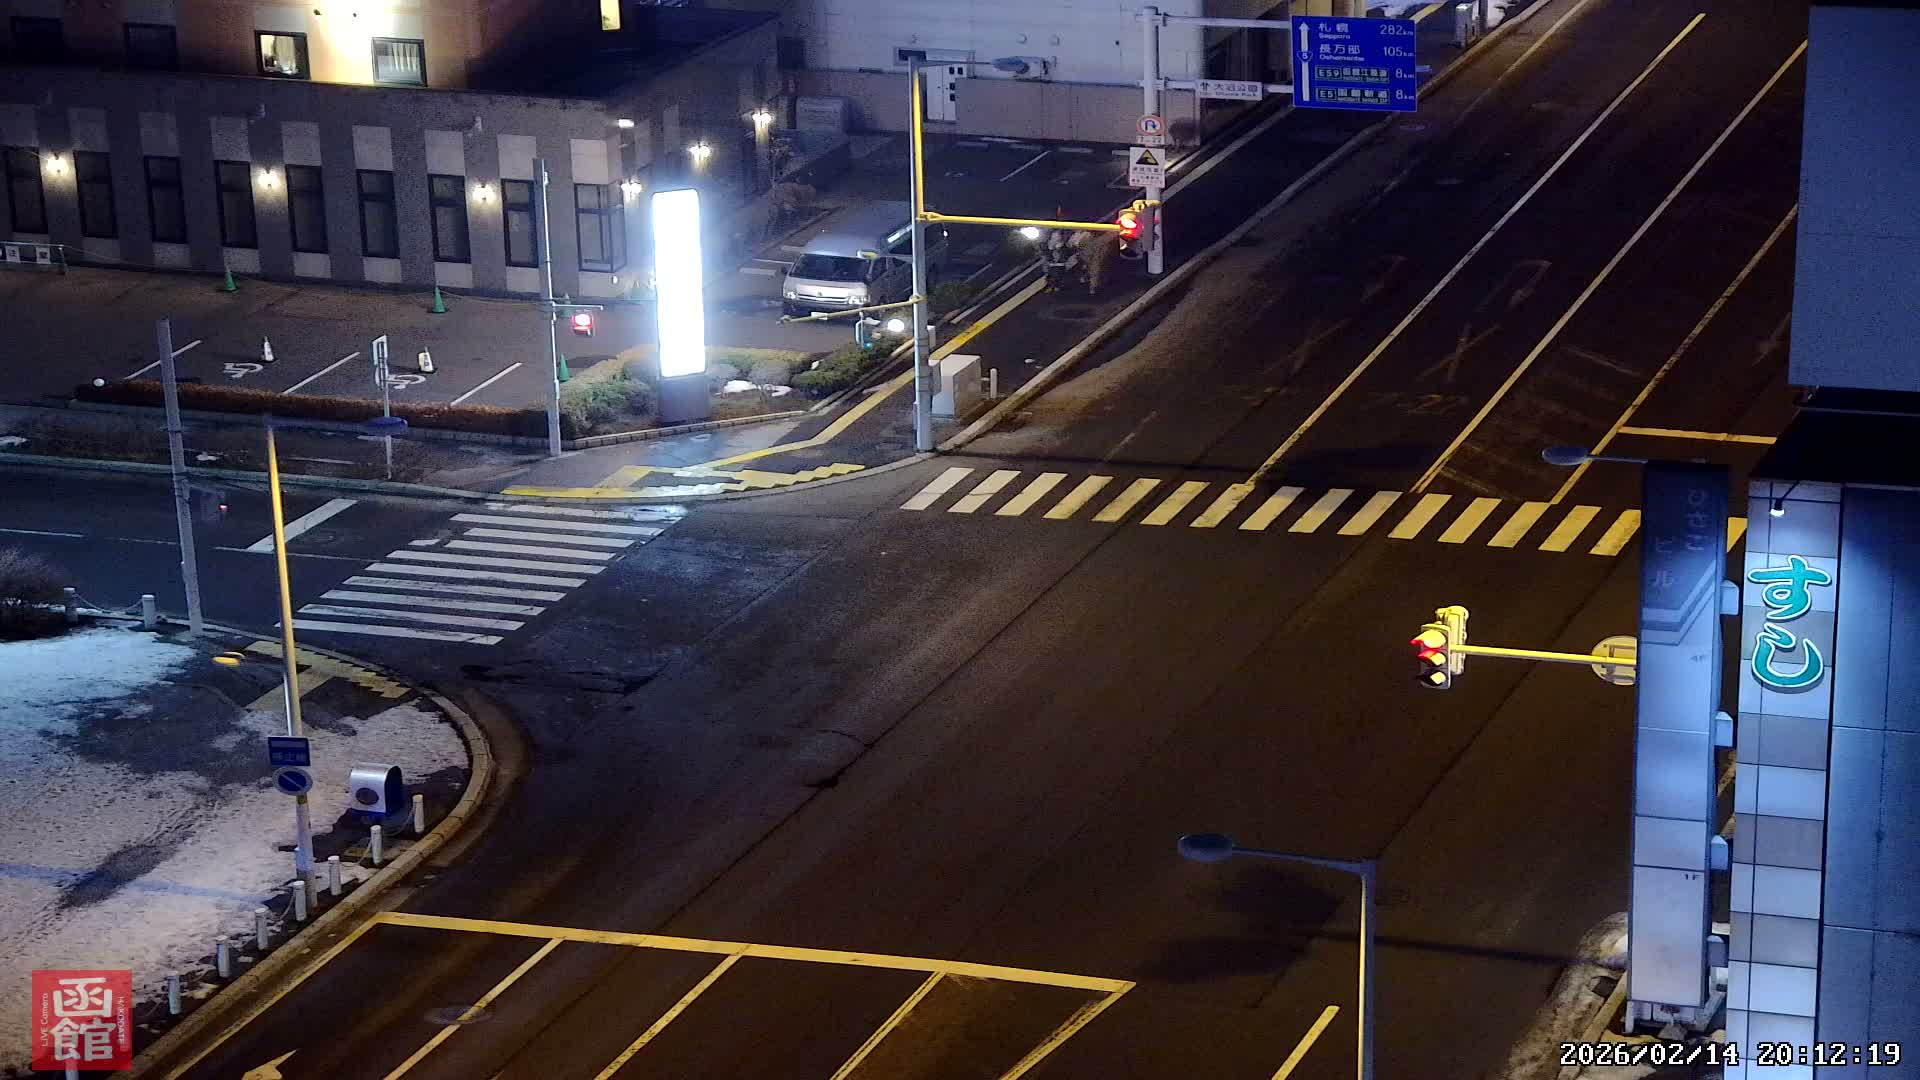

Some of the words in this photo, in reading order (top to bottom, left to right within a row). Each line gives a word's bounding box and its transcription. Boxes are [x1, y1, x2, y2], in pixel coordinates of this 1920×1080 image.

[1320, 44, 1361, 54] 長万部
[1318, 69, 1340, 77] E59
[1319, 90, 1334, 98] E5
[1747, 555, 1831, 688] すし
